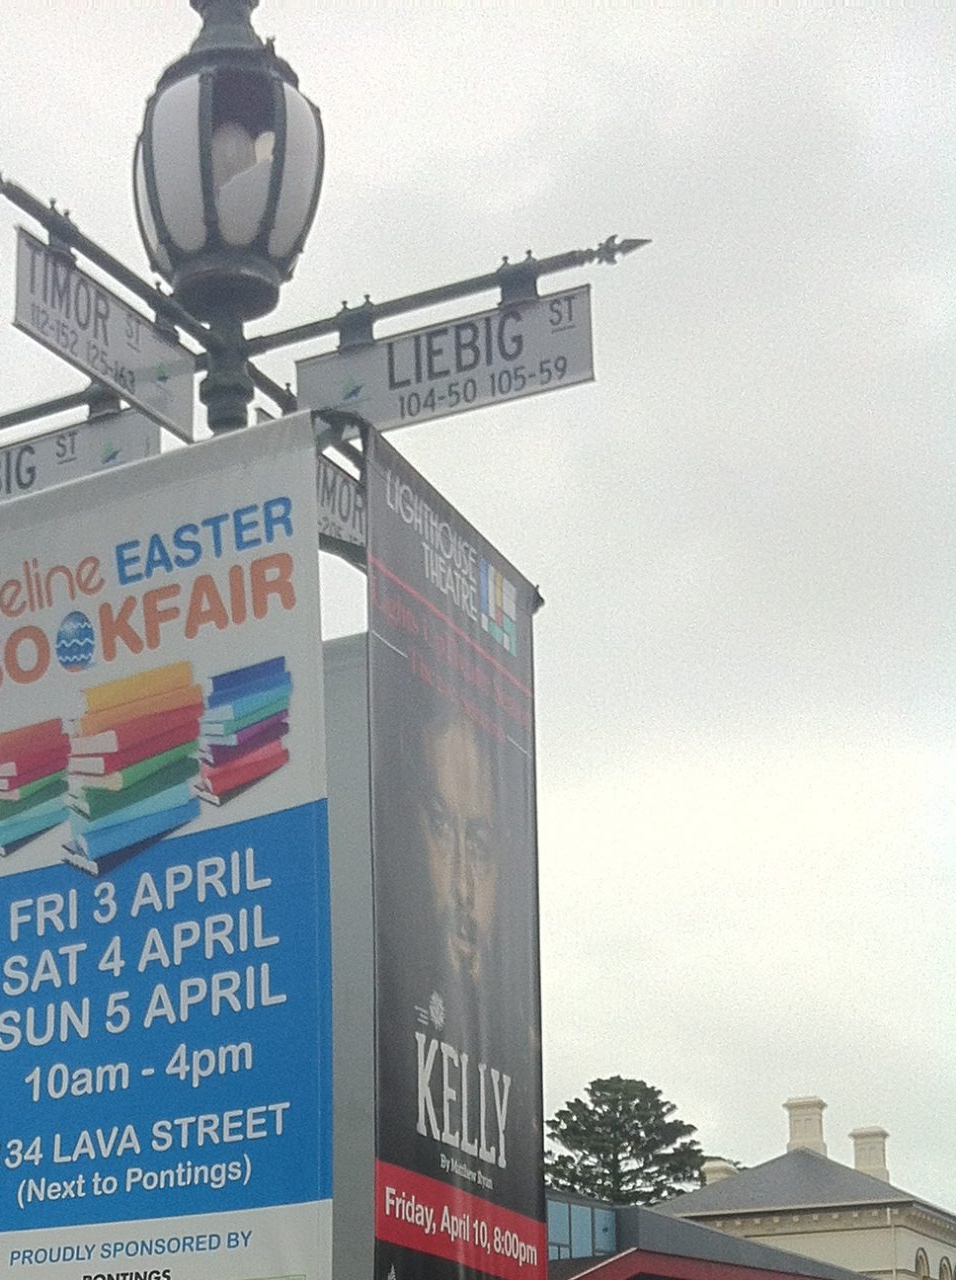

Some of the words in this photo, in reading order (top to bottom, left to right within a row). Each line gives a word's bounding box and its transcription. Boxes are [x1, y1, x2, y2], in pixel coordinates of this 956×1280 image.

[25, 240, 109, 346] TIMOR
[126, 312, 144, 348] ST
[387, 309, 523, 390] LIEBIG
[549, 296, 575, 326] ST
[399, 377, 477, 419] 104-50
[490, 355, 567, 397] 105-59
[55, 431, 78, 458] ST
[115, 496, 293, 586] EASTER
[386, 469, 478, 585] LIGHTHOUSE
[422, 542, 478, 622] THEATRE
[9, 889, 78, 941] FRI
[93, 881, 118, 924] 3
[130, 847, 272, 918] APRIL
[2, 943, 87, 996] SAT
[98, 936, 125, 977] 4
[137, 904, 280, 972] APRIL
[105, 991, 131, 1034] 5
[143, 962, 287, 1029] APRIL
[24, 1062, 129, 1102] 10am
[165, 1041, 253, 1088] 4pm
[415, 1031, 511, 1169] KELLY
[52, 1125, 140, 1163] LAVA
[151, 1102, 290, 1152] STREET
[16, 1173, 86, 1209] (Next
[92, 1172, 118, 1196] to
[125, 1153, 252, 1194] Pontings)
[9, 1244, 96, 1266] PROUDLY
[100, 1233, 222, 1260] SPONSORED
[227, 1231, 252, 1249] BY
[385, 1186, 437, 1234] Friday,
[440, 1205, 470, 1242] April
[472, 1219, 491, 1255] 10,
[493, 1226, 538, 1266] 8:00pm
